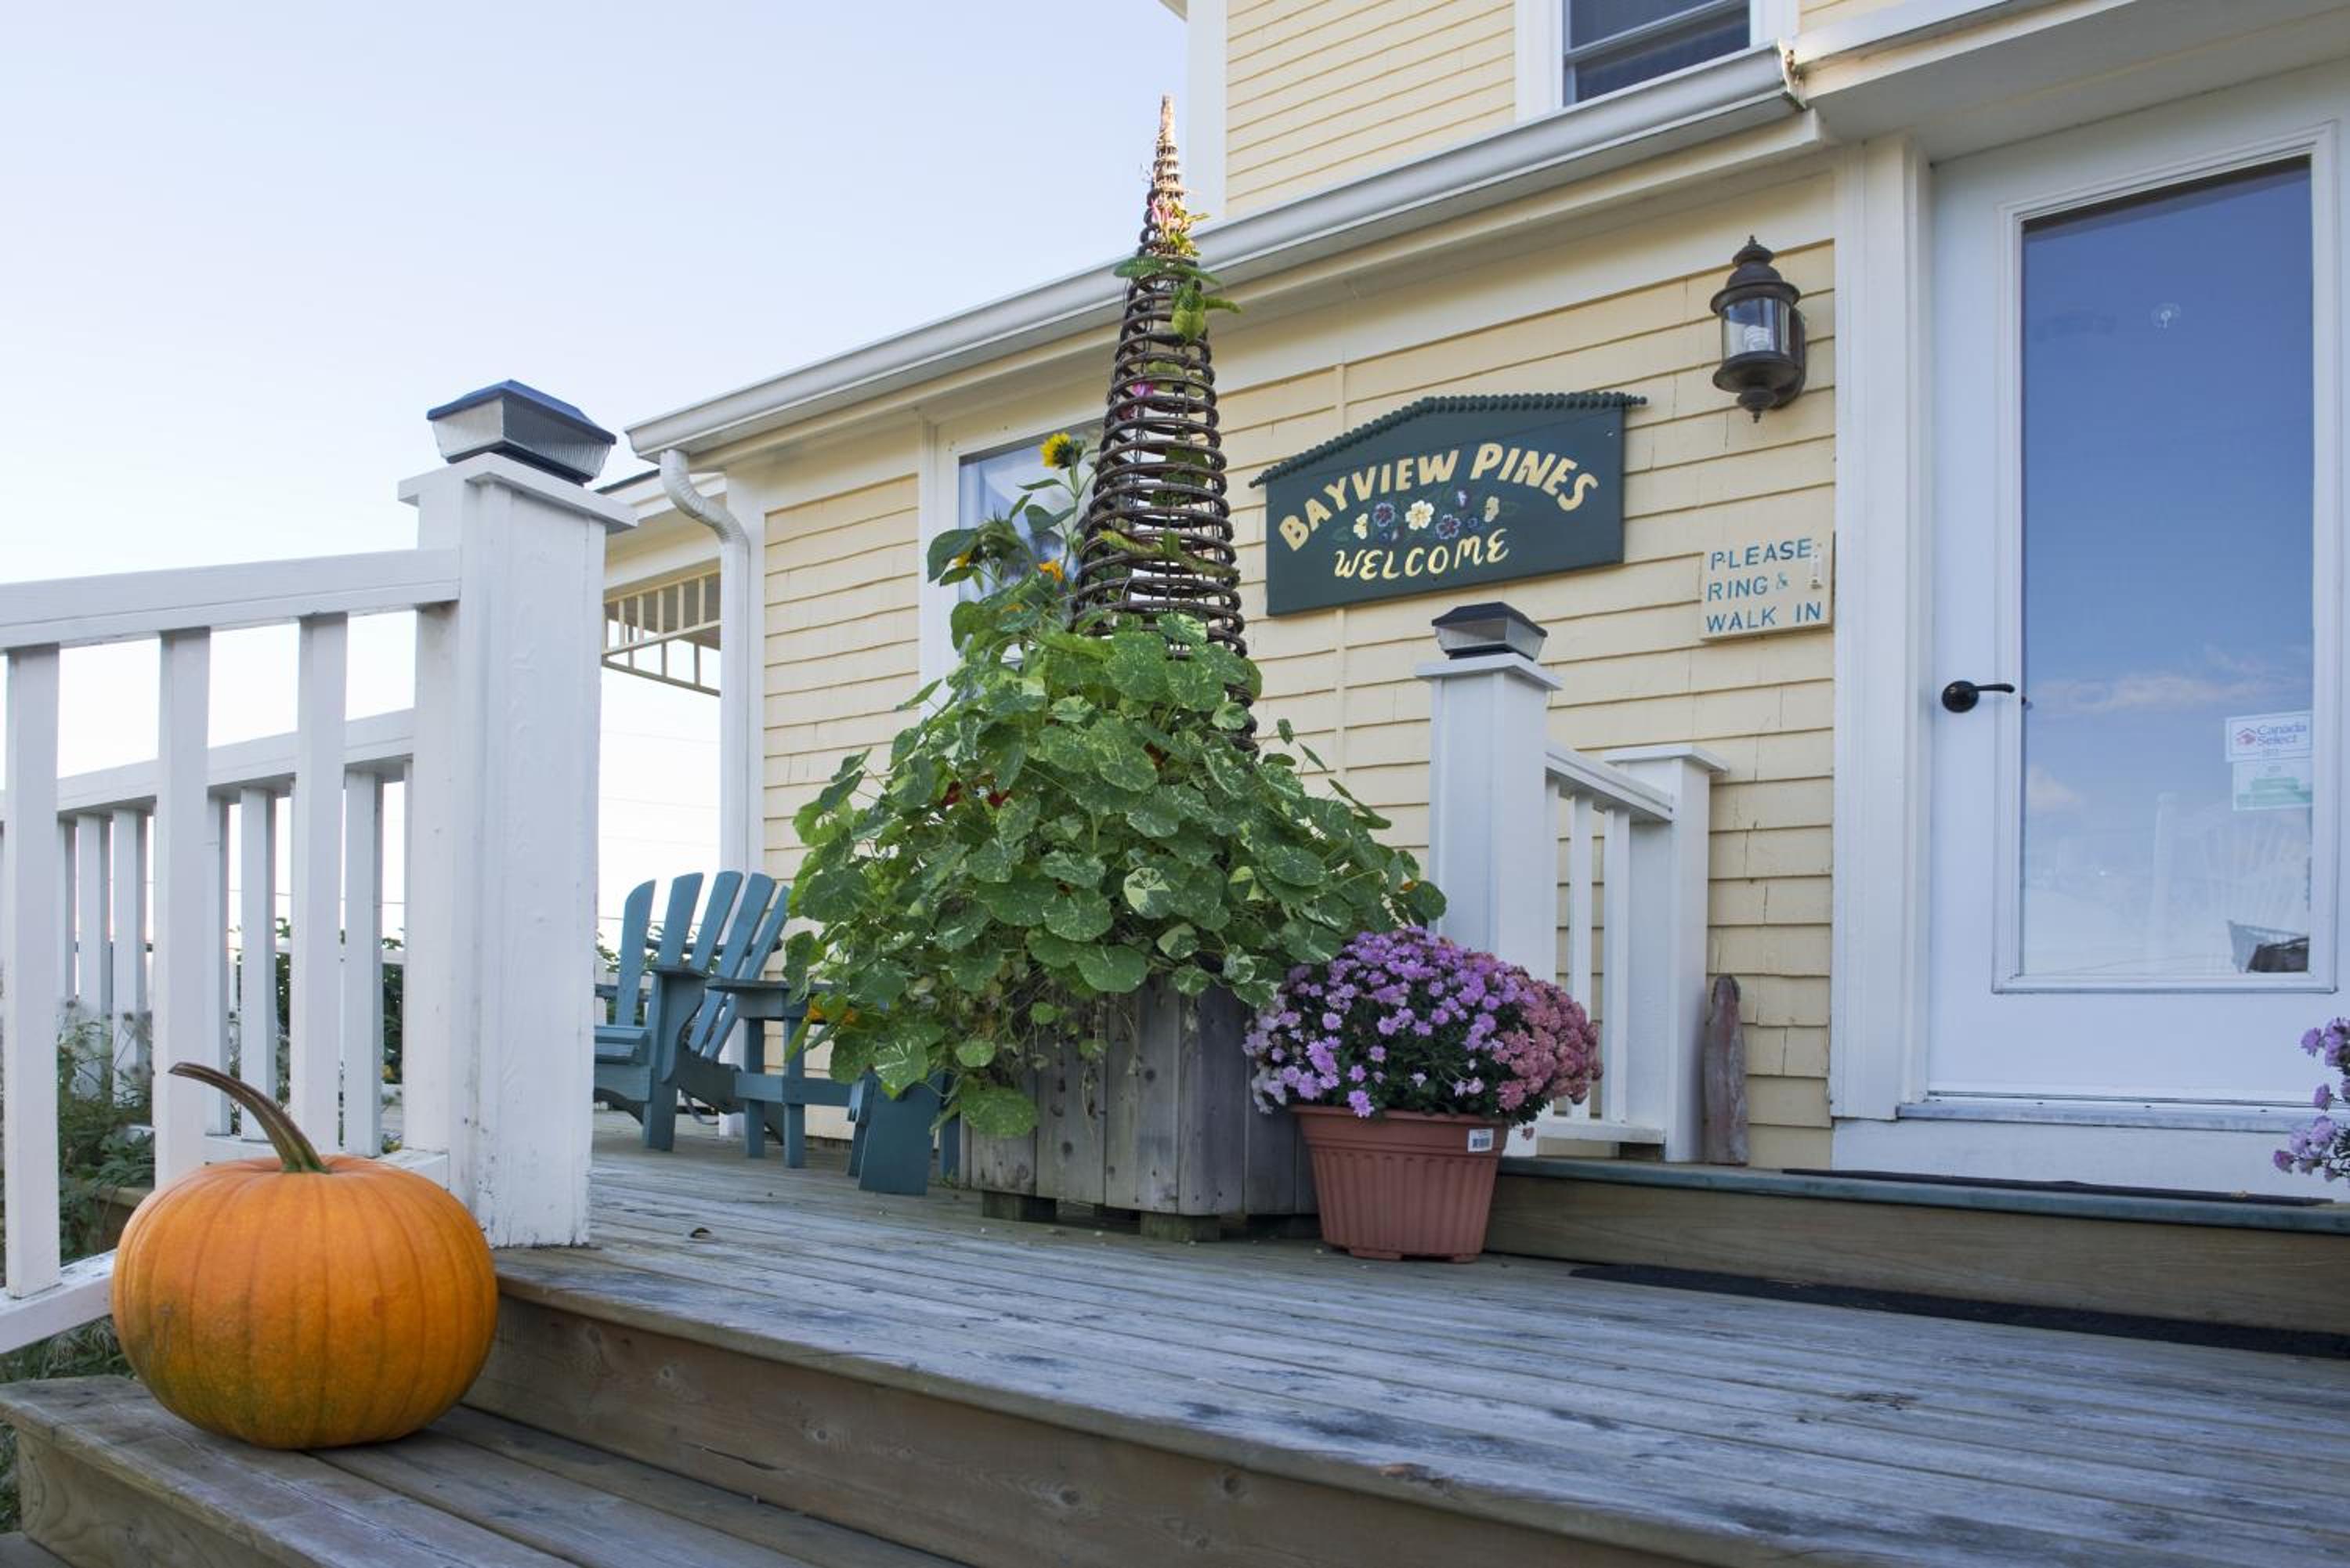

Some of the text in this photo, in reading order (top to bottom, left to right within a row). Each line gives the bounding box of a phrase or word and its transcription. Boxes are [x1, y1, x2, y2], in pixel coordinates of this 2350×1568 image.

[1279, 443, 1599, 551] BAYVIEW PINES
[1334, 529, 1509, 581] WELCOME
[1711, 538, 1813, 570] PLEASE
[1707, 576, 1768, 602] RING
[1707, 601, 1821, 632] WALK IN
